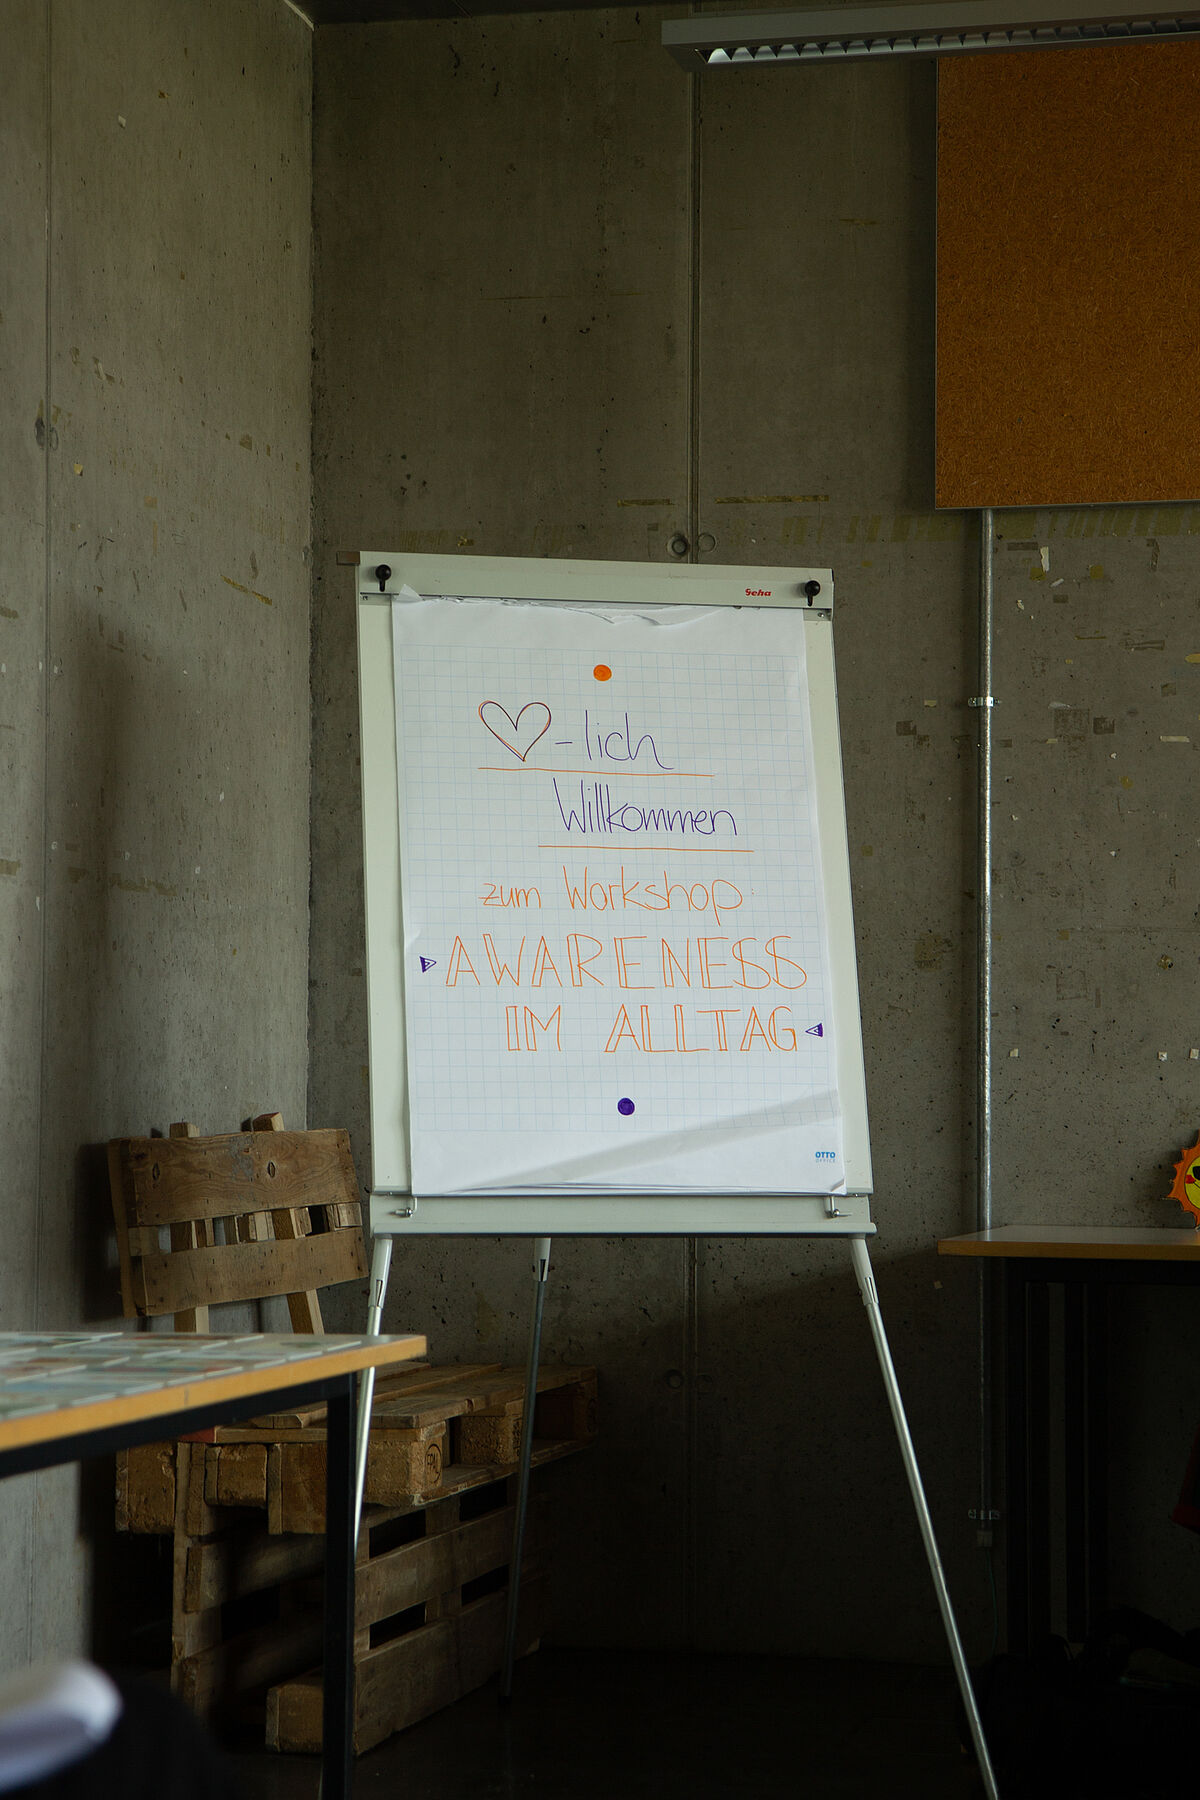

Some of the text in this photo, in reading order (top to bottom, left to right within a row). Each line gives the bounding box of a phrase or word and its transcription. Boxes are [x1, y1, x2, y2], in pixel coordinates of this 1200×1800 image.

[553, 777, 737, 836] Willkommen
[478, 883, 541, 908] zum
[446, 933, 807, 989] AWARENESS
[505, 1003, 797, 1053] IM ALLTAG
[815, 1151, 836, 1159] OTTO
